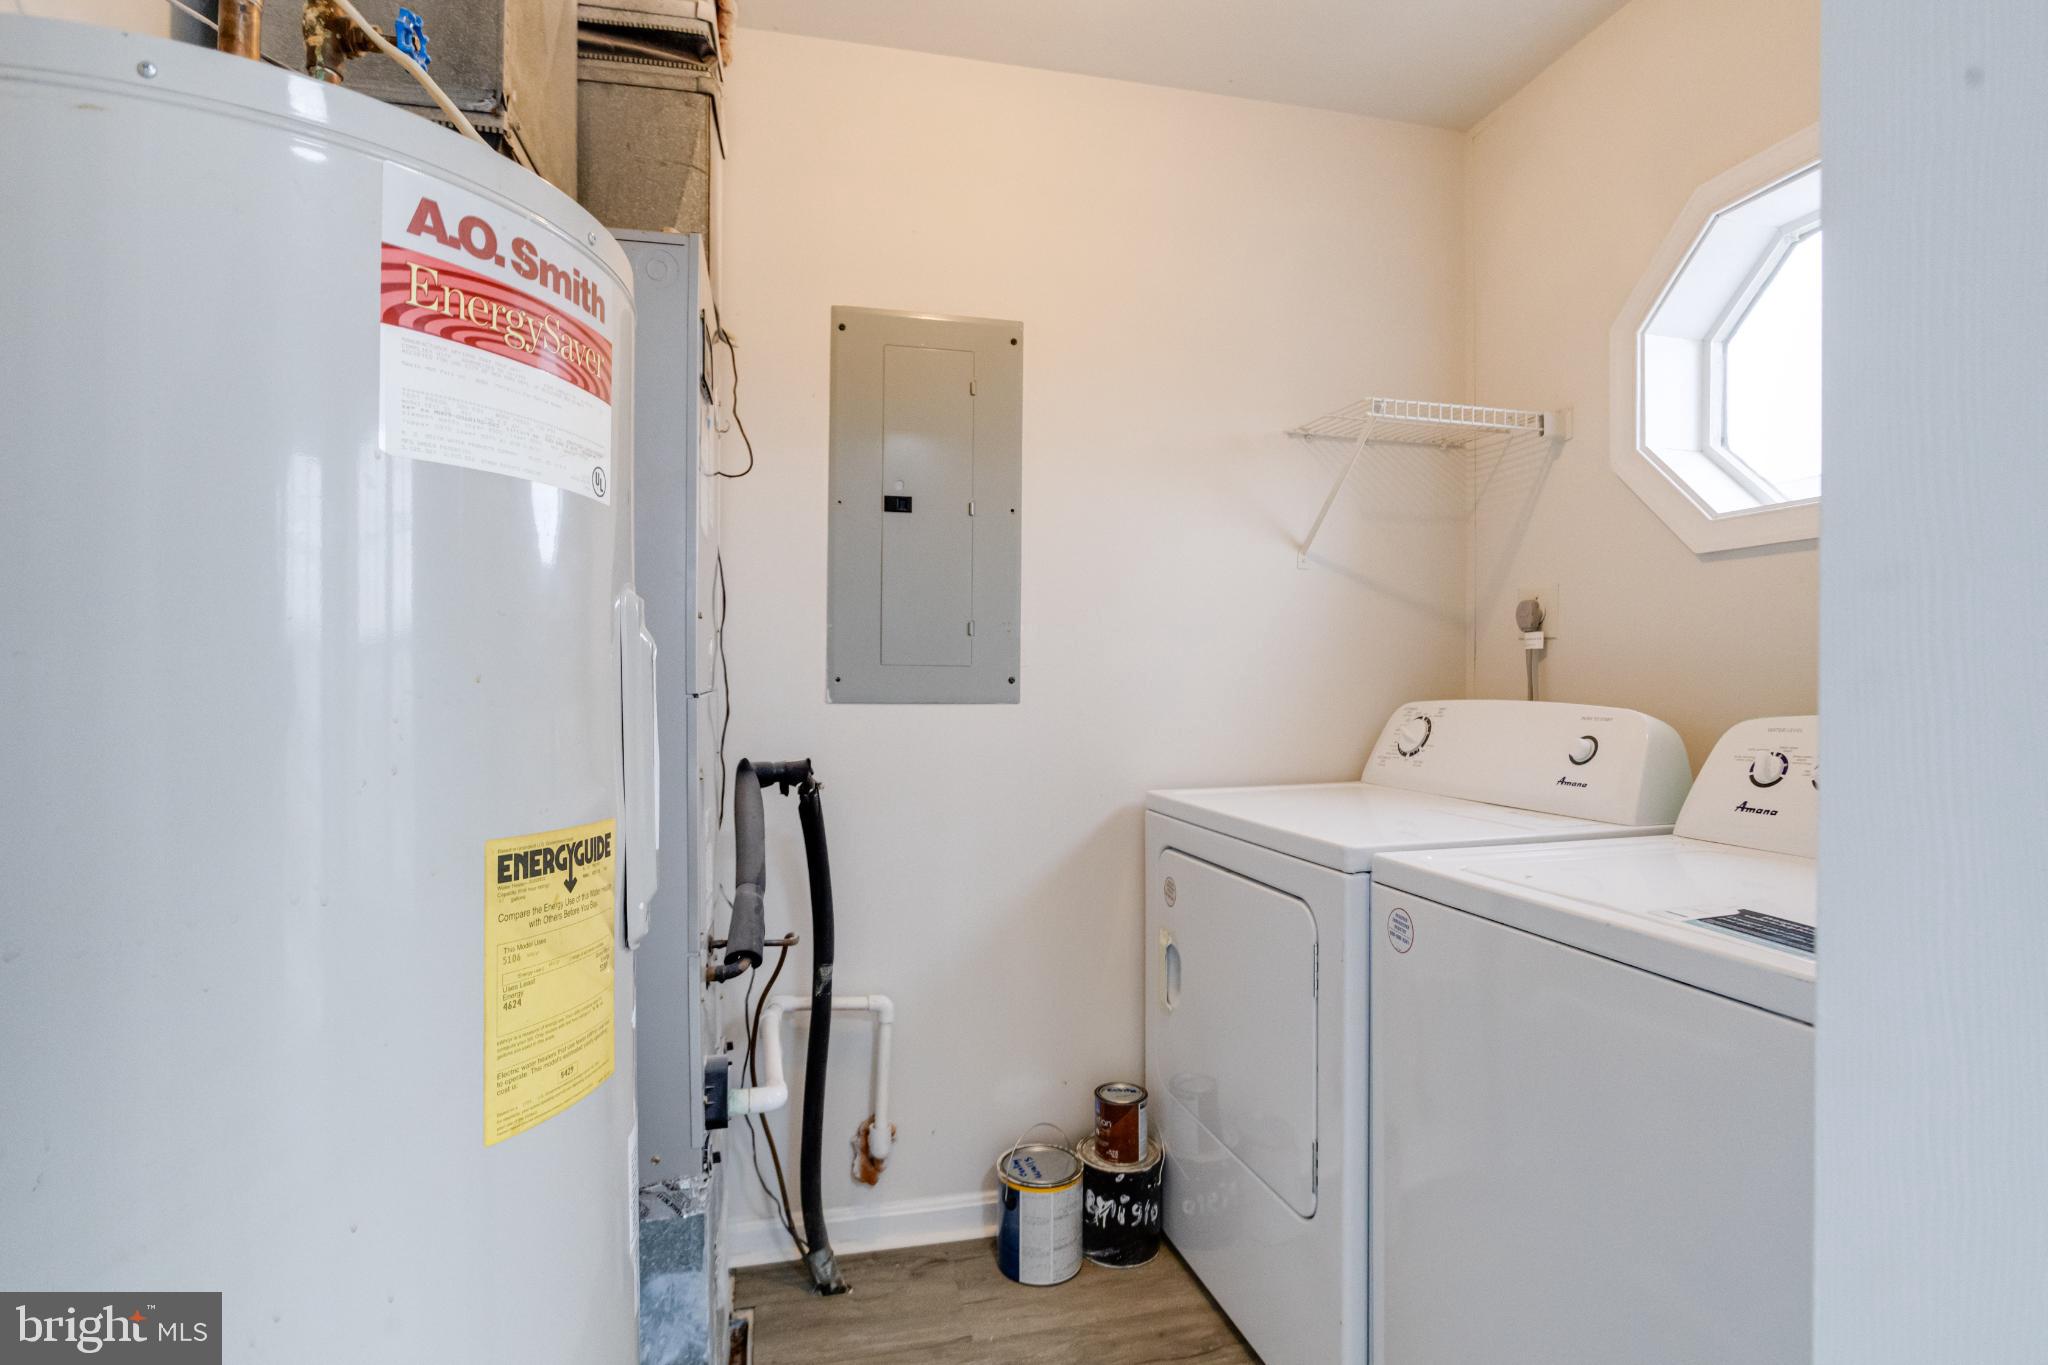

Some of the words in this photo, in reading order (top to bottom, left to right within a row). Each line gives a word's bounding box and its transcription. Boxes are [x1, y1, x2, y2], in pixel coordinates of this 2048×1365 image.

[407, 197, 505, 268] A.O.
[510, 237, 606, 324] Smith
[404, 261, 605, 378] EnergySaver
[1557, 776, 1588, 788] Amana
[1734, 800, 1778, 816] Amana
[497, 832, 612, 884] ENERGYGUIDE
[498, 908, 530, 923] Compare
[532, 905, 543, 914] the
[543, 900, 564, 913] Energy
[564, 896, 575, 906] Use
[528, 919, 542, 928] with
[543, 912, 562, 924] Others
[563, 906, 580, 919] Before
[580, 903, 590, 913] You
[502, 998, 522, 1011] 4624
[496, 1067, 519, 1080] Electric
